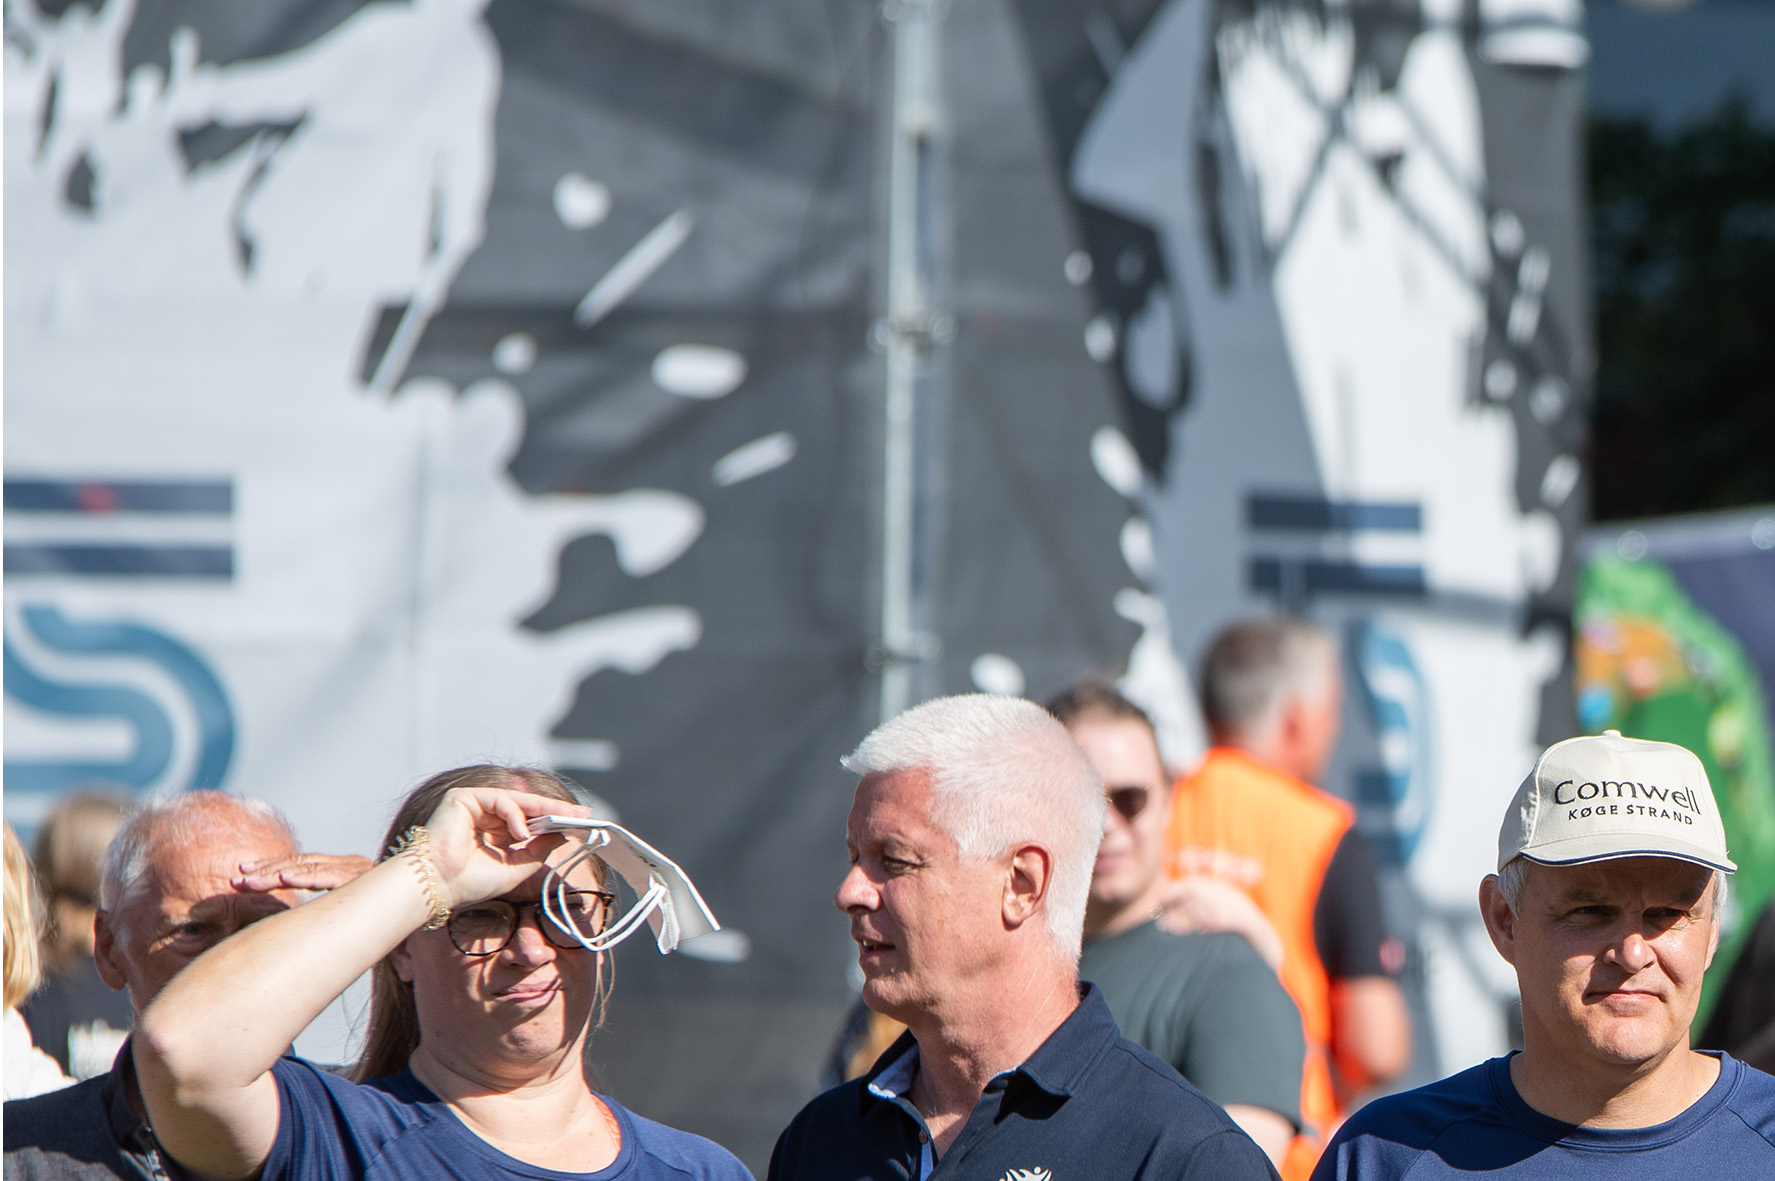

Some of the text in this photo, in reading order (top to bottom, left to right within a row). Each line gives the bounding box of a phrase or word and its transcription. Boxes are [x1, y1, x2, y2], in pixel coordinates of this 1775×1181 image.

[1554, 779, 1702, 815] Comwell
[1568, 804, 1693, 825] KØGE STRAND
